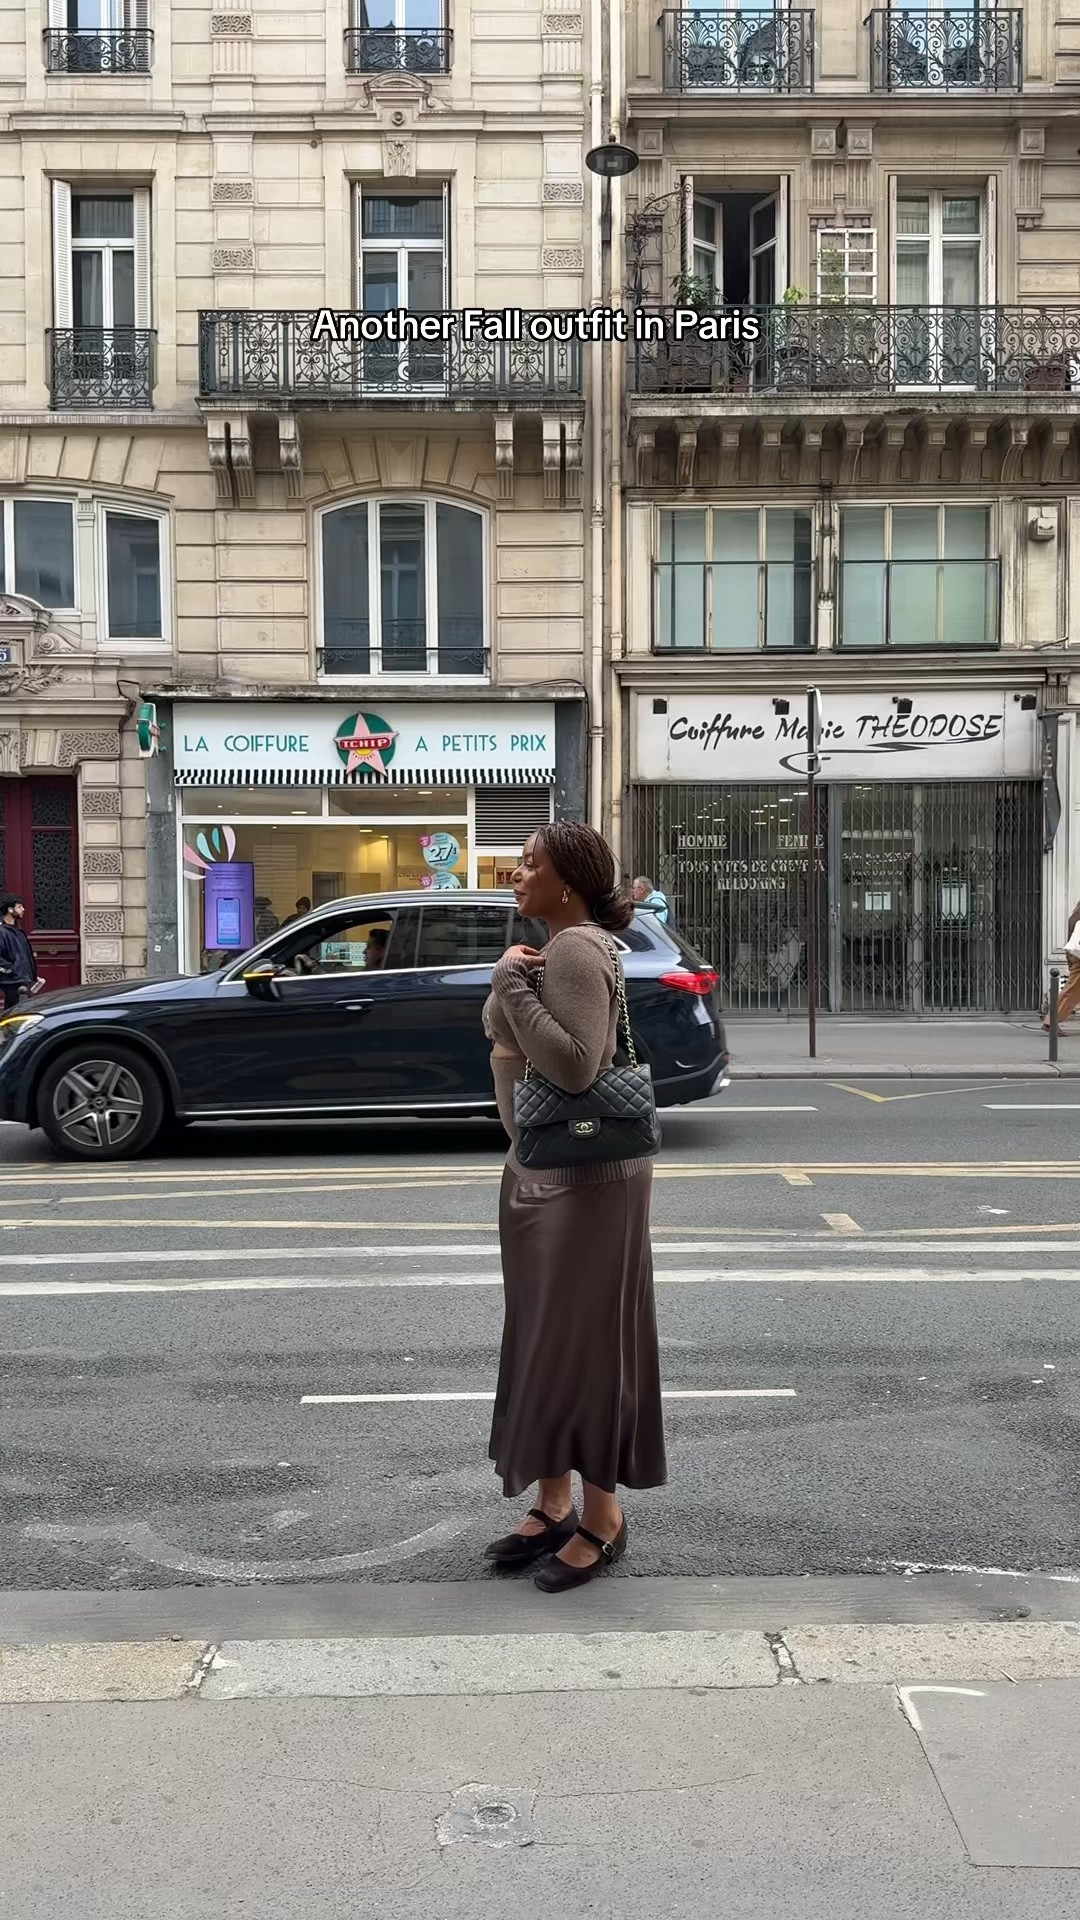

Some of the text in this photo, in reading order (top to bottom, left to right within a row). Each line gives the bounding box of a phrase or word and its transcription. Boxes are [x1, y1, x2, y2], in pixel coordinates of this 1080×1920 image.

[669, 713, 765, 751] Coiffure
[775, 717, 845, 741] Maie
[184, 734, 310, 752] LA COIFFURE
[343, 739, 388, 748] TCHIP
[415, 734, 547, 752] A PETITS PRIX
[677, 834, 728, 847] HOMME
